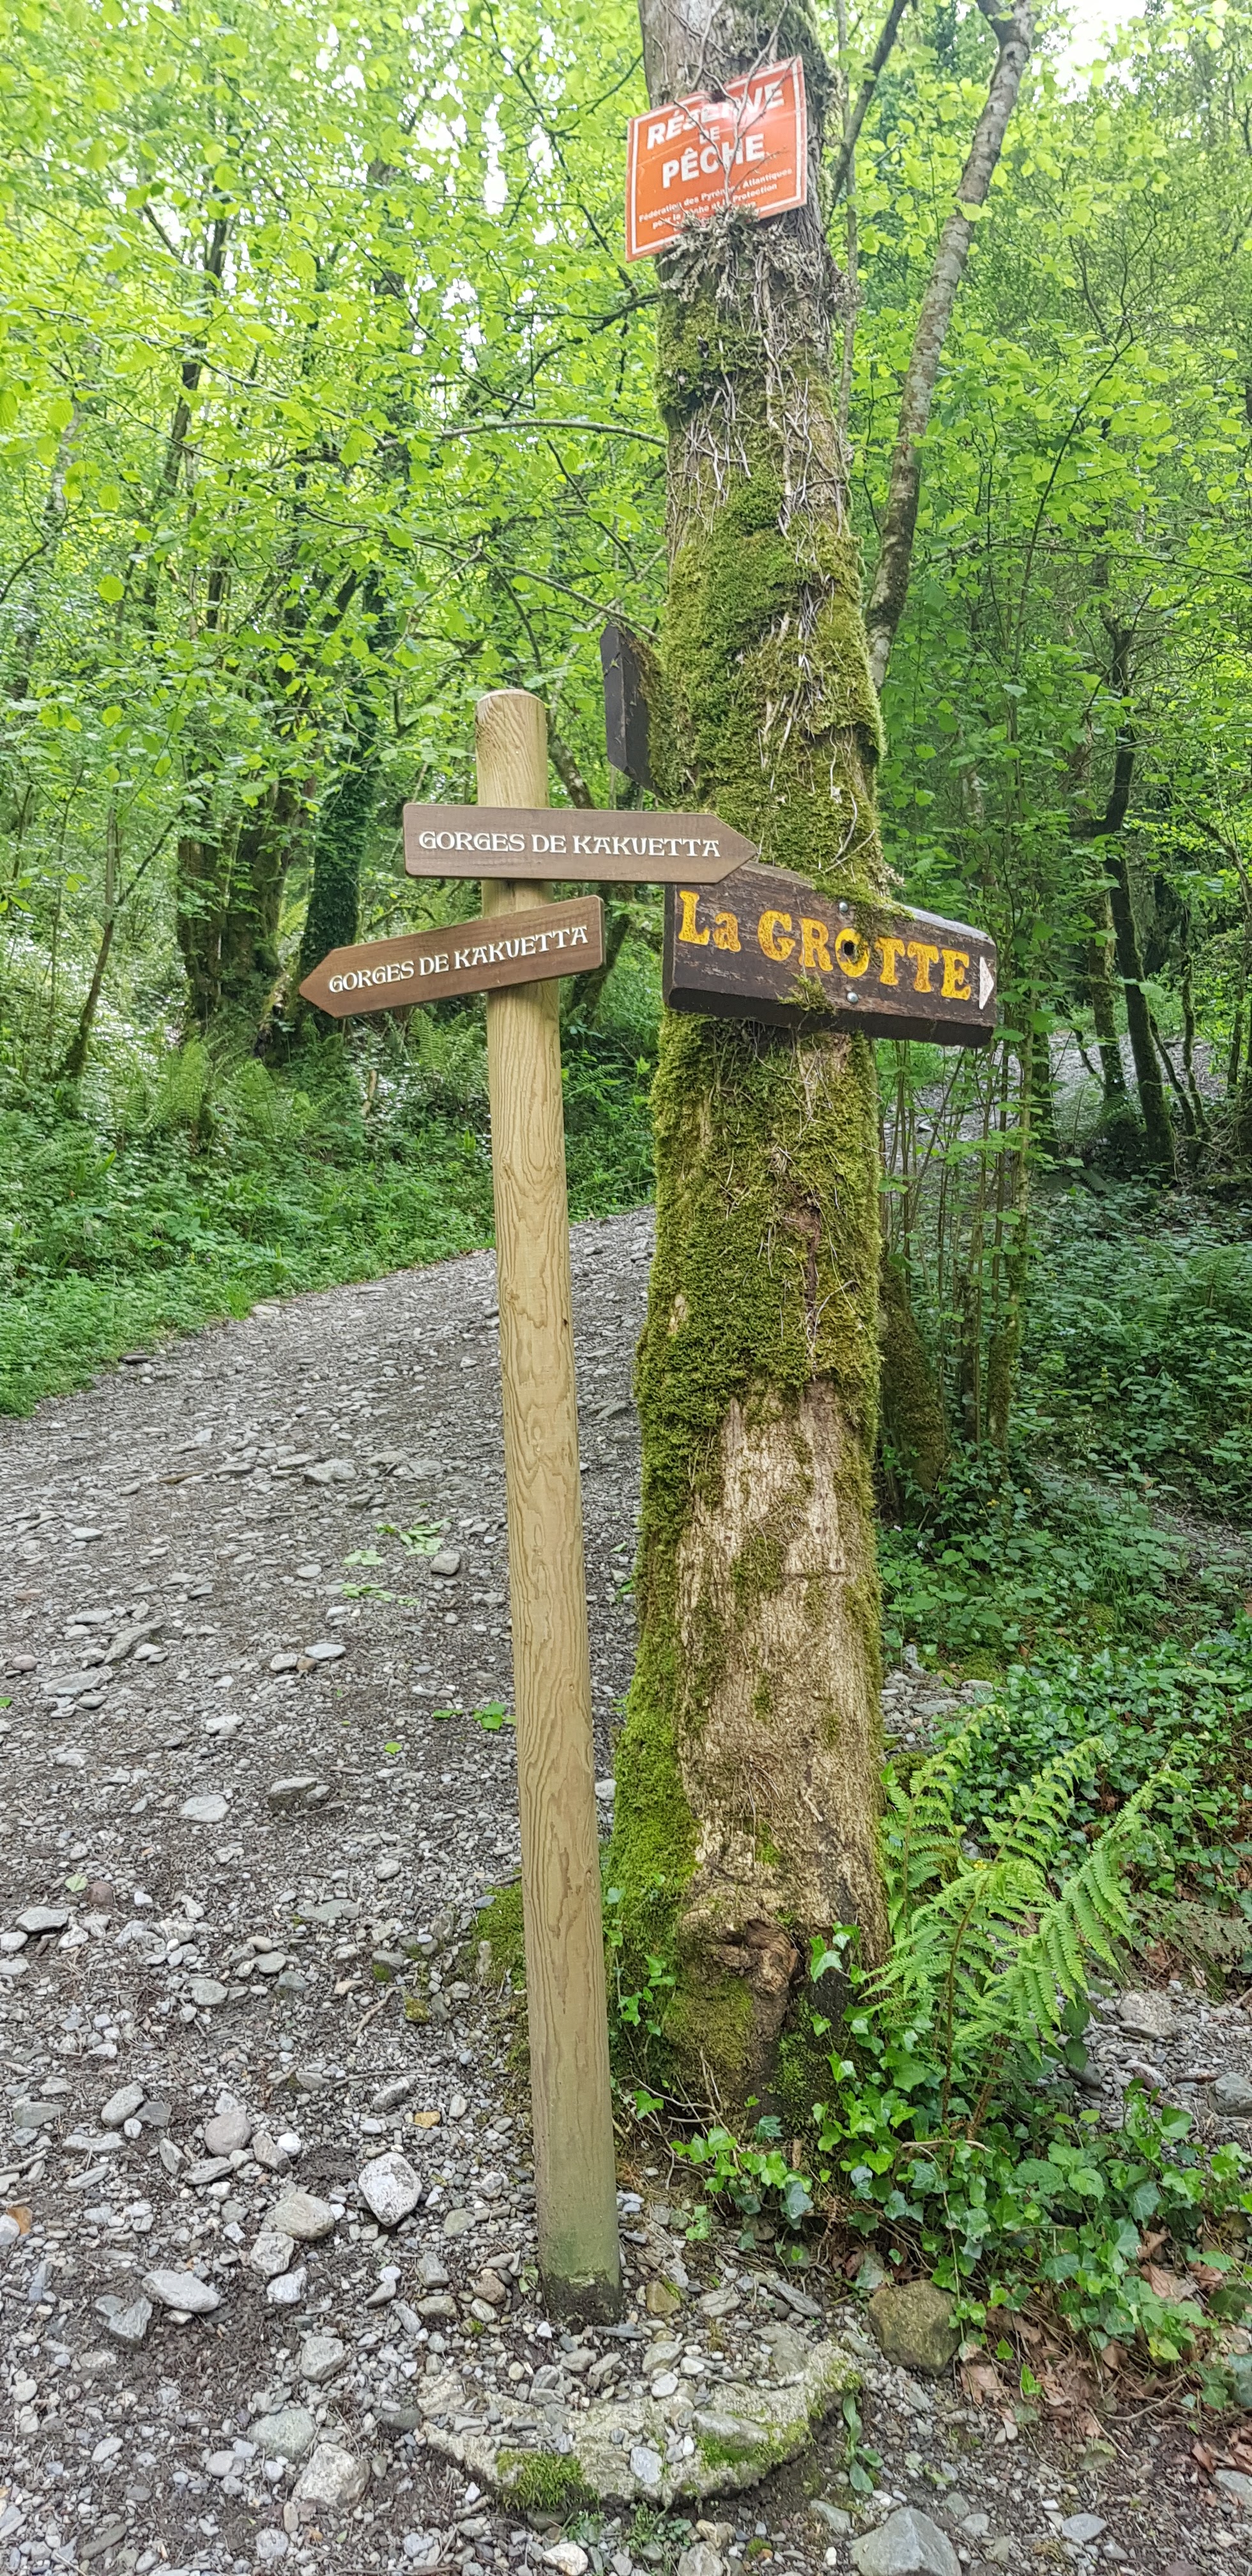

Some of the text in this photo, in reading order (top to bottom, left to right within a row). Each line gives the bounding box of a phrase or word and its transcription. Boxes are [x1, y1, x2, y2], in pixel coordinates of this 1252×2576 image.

[646, 80, 784, 150] RÉSERVE
[699, 126, 721, 144] DE
[662, 133, 765, 189] PÊCHE
[683, 196, 699, 206] des
[742, 168, 792, 189] Atlantiques
[732, 183, 777, 203] Protection
[418, 831, 721, 858] GORGES DE KAKUETTA
[328, 925, 589, 994] GORGES DE KAKUETTA
[678, 890, 972, 1001] La GROTTE
